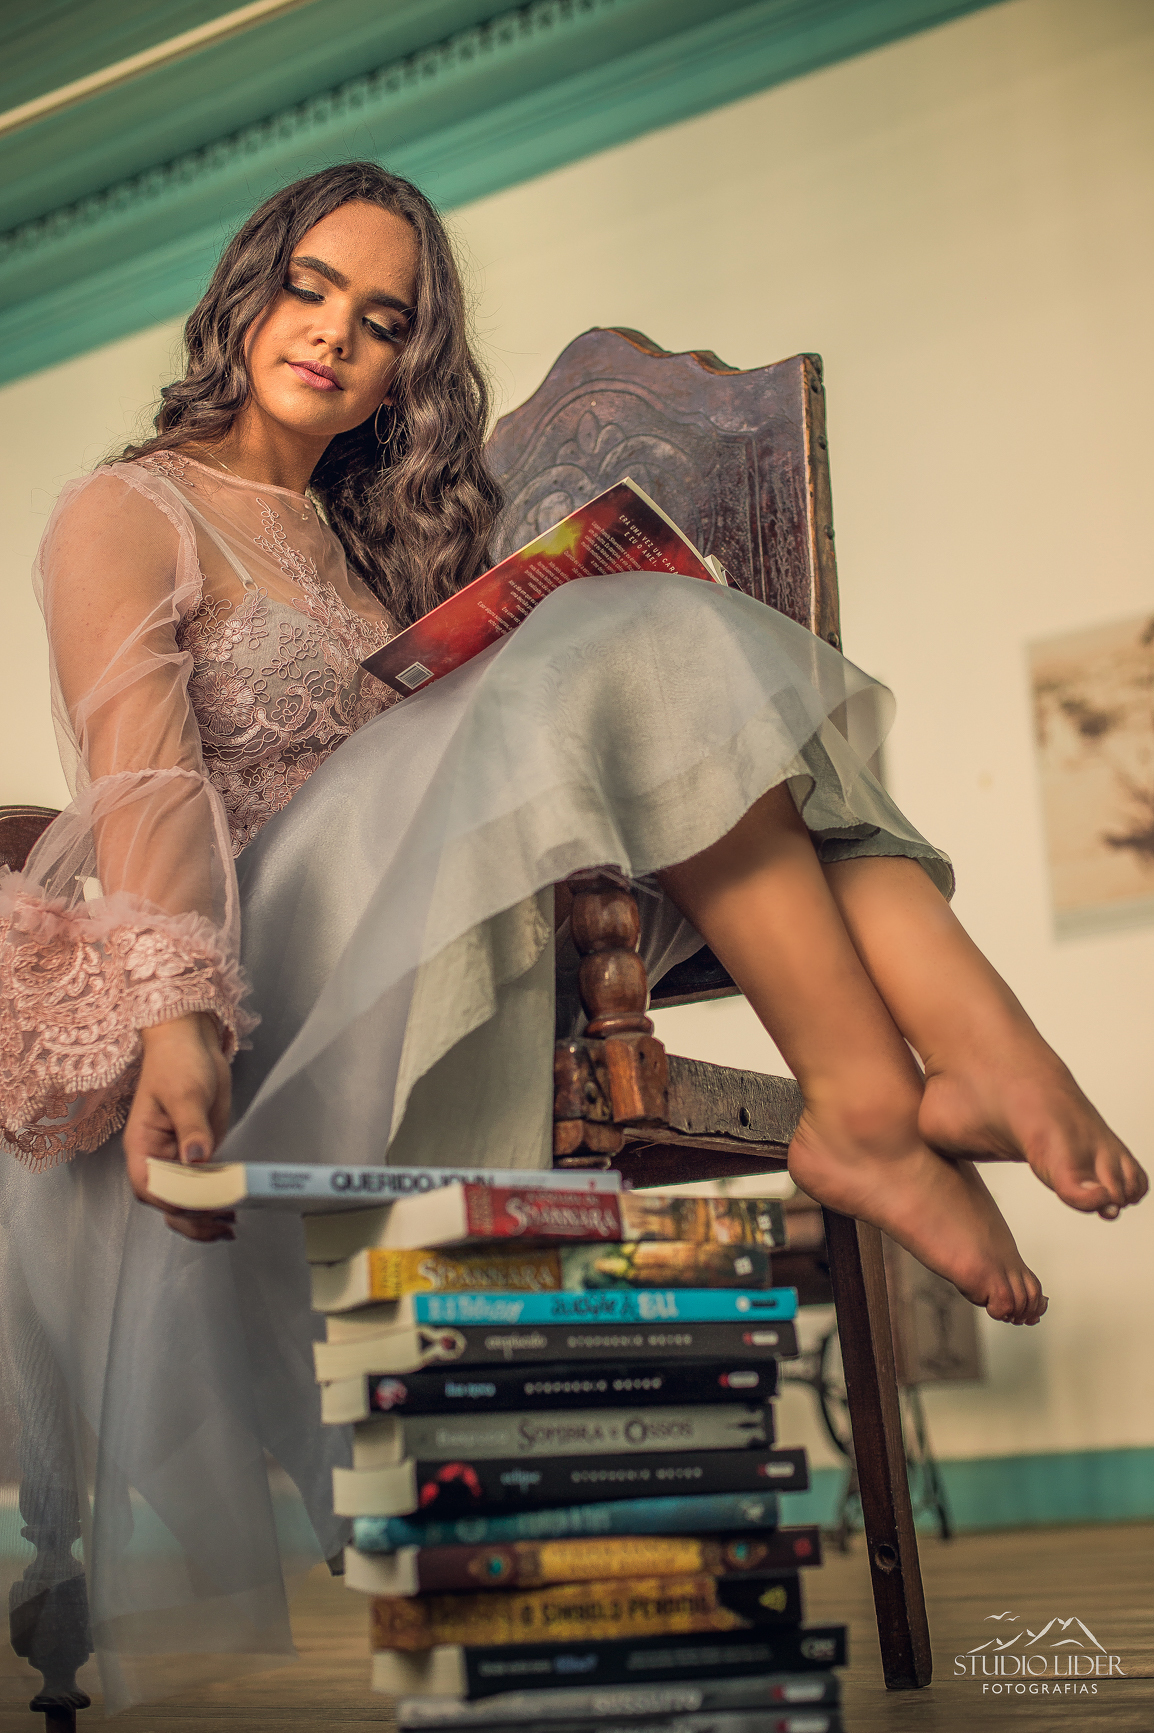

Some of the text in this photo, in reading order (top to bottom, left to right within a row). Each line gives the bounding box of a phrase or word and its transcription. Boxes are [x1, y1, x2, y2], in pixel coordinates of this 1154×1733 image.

[617, 513, 632, 526] ERA
[628, 524, 643, 537] UMA
[640, 535, 654, 548] VEZ
[650, 547, 663, 557] UM
[627, 535, 638, 544] EU
[330, 1170, 431, 1194] QUERIDO
